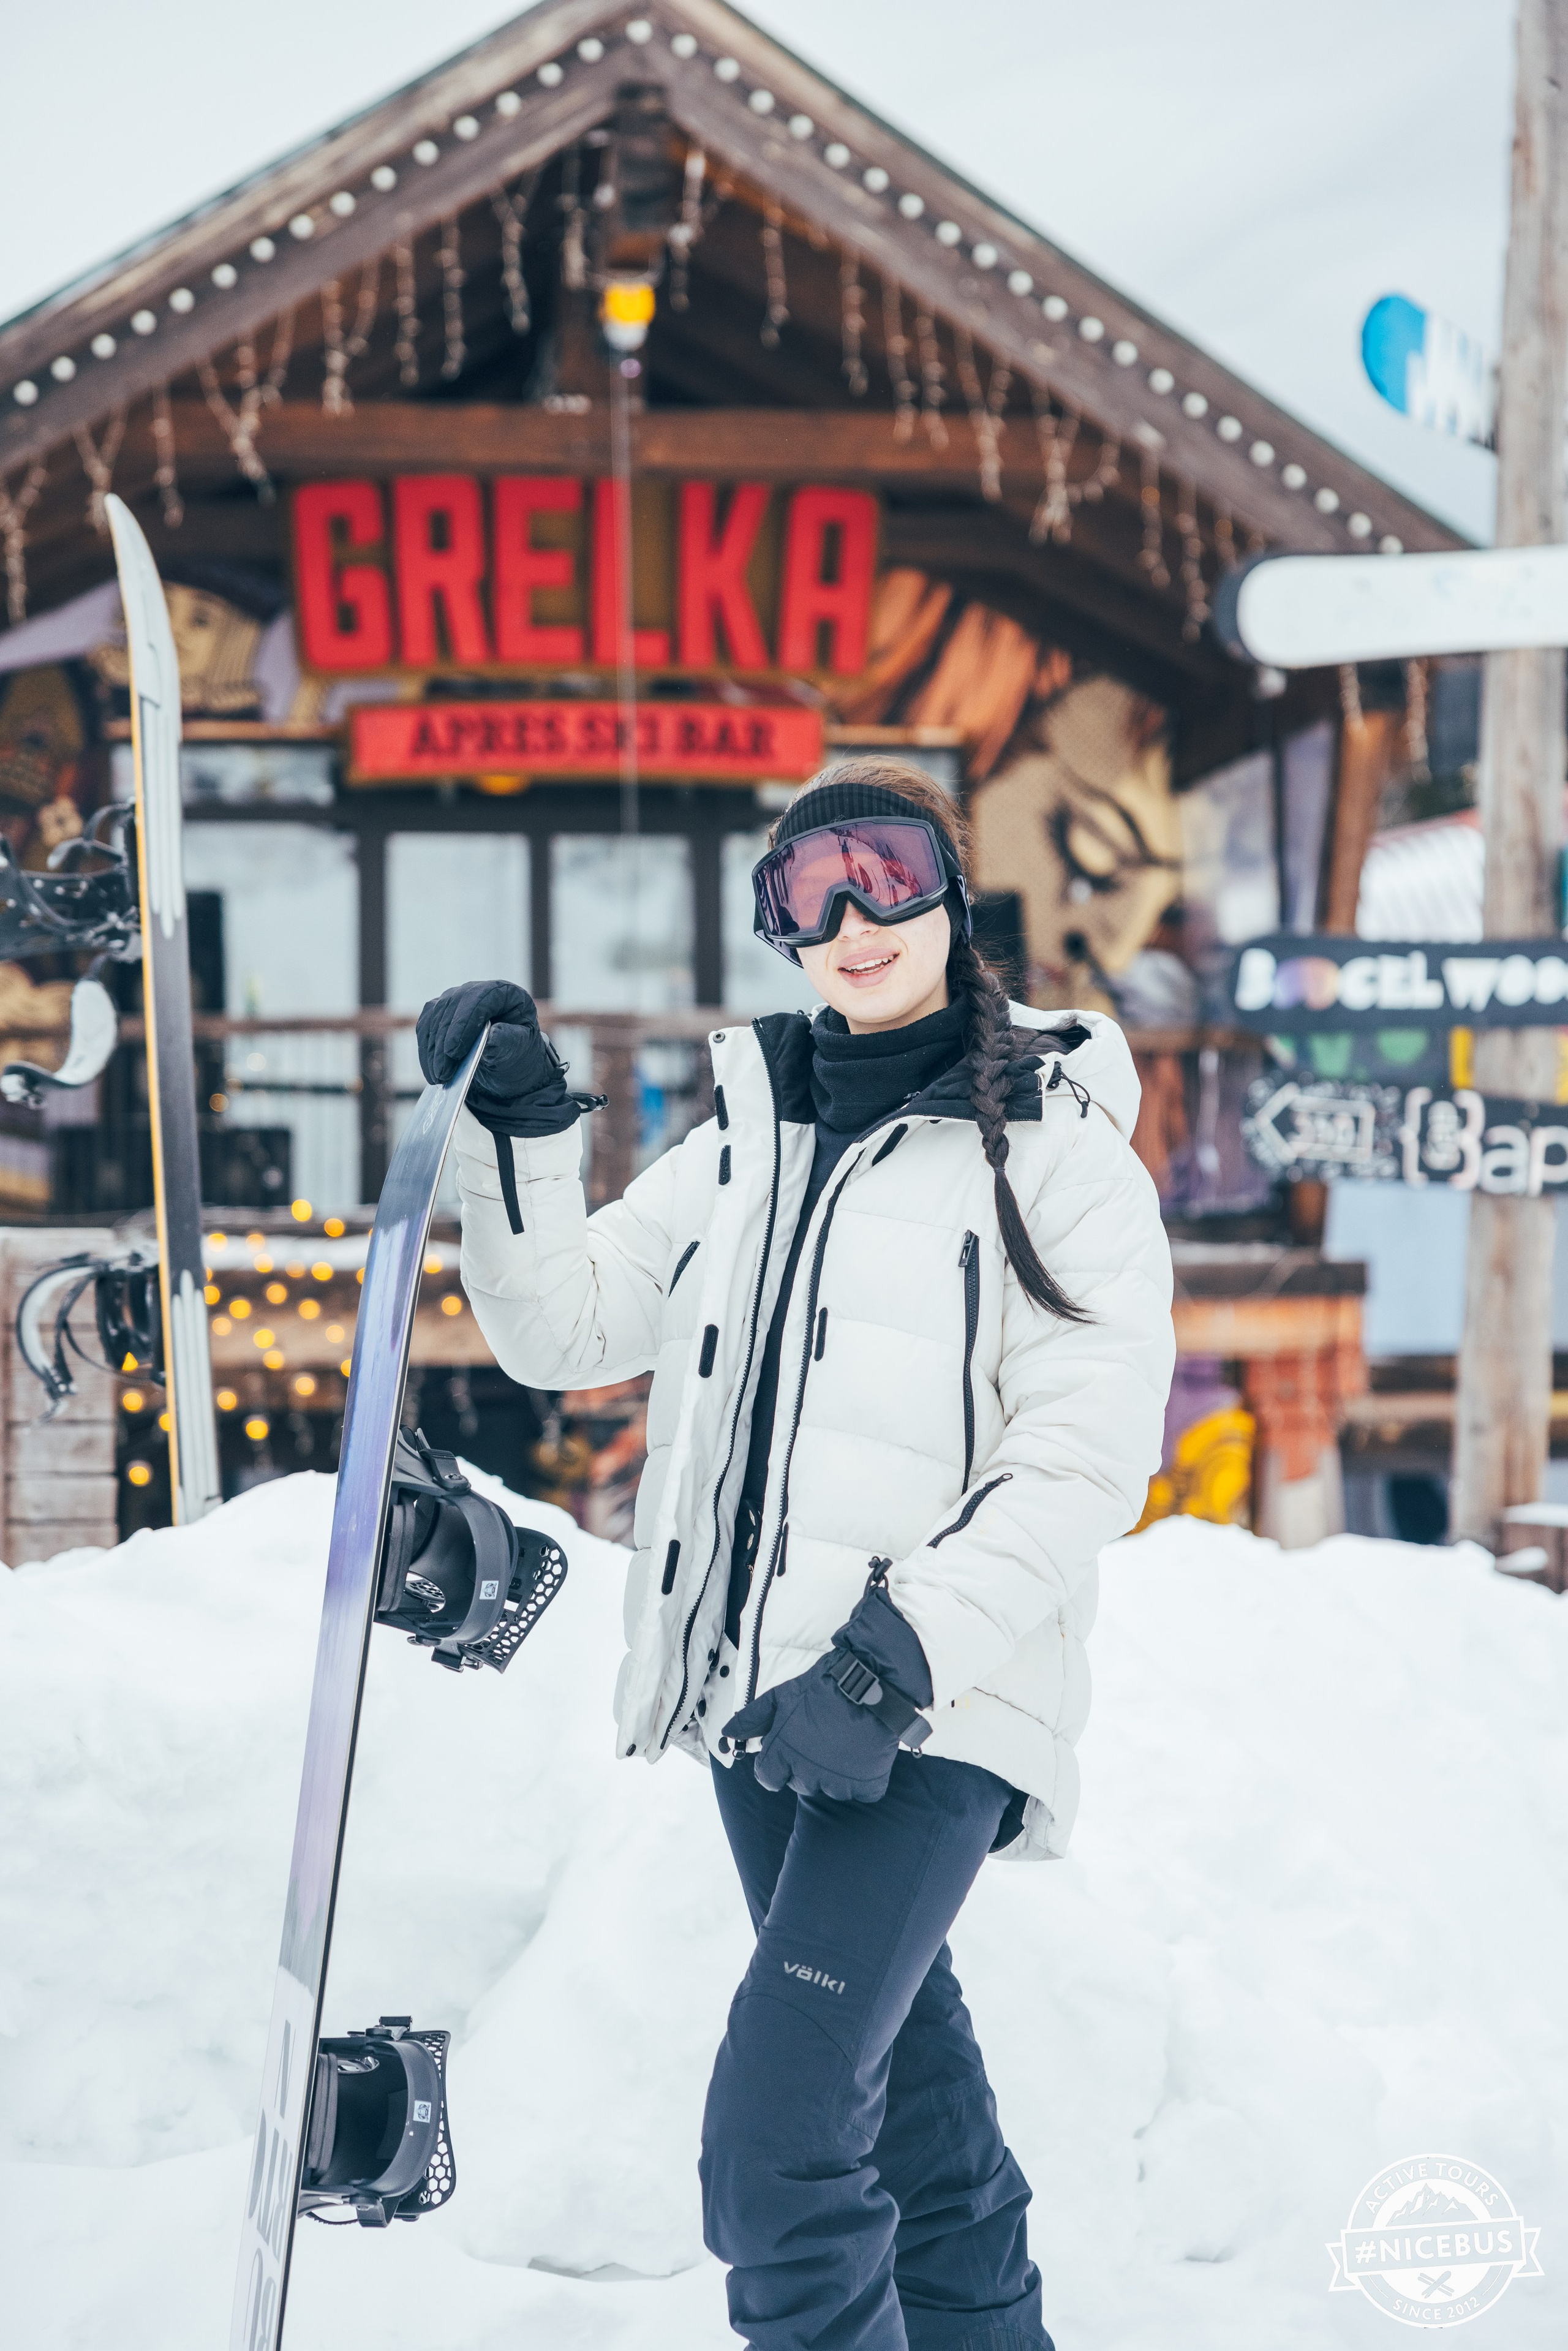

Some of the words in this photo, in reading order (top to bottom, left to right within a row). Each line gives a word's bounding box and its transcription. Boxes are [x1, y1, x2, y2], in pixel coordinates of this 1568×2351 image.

[293, 473, 880, 676] GRELKA
[675, 714, 774, 761] BAR
[1441, 953, 1568, 1013] WOO
